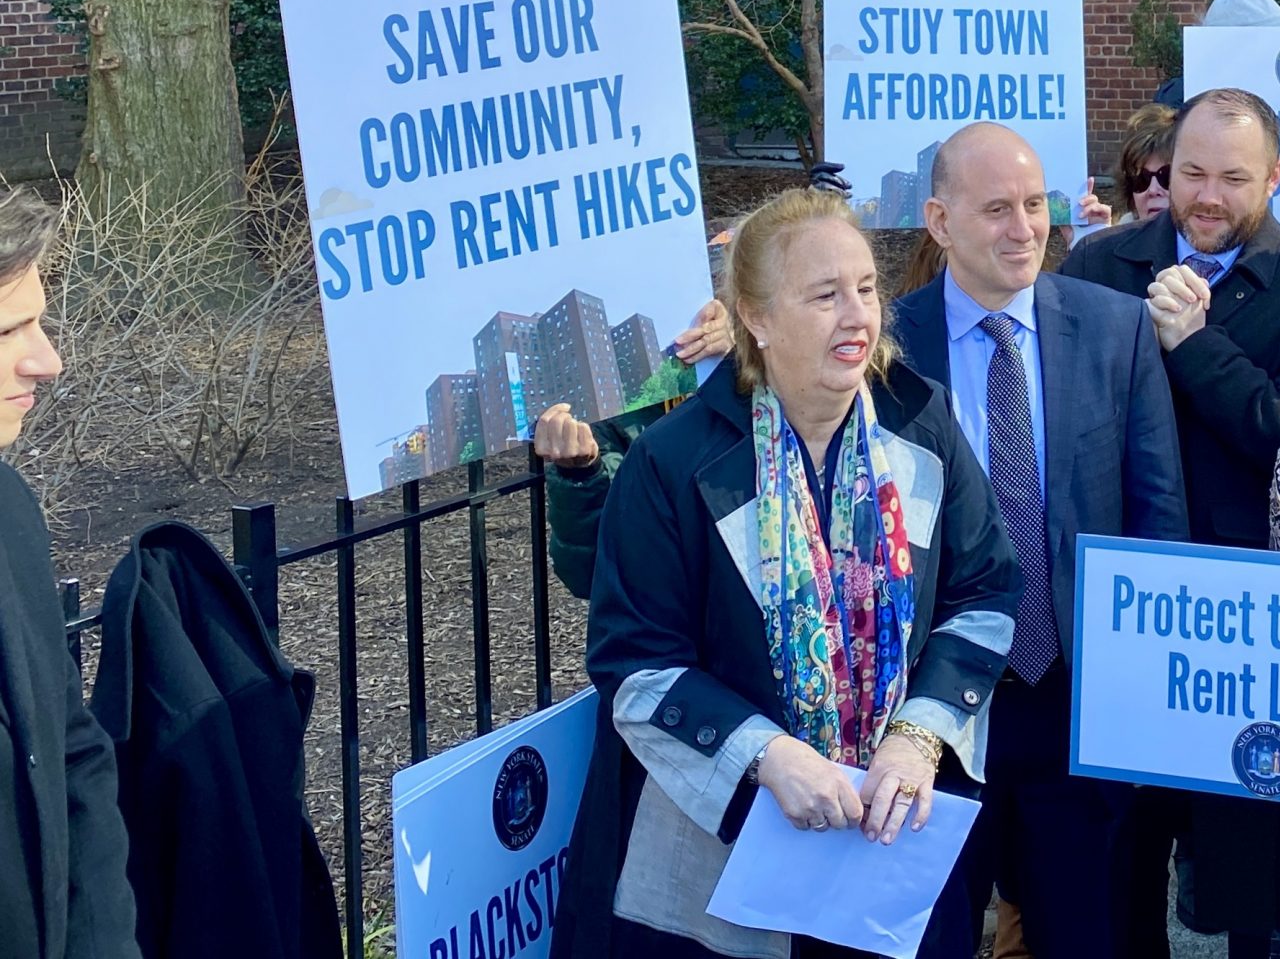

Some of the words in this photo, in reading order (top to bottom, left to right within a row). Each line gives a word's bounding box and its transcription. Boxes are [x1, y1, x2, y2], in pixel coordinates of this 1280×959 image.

[383, 1, 501, 85] SAVE
[858, 6, 944, 55] STUY
[953, 9, 1049, 56] TOWN
[360, 74, 642, 189] COMMUNITY,
[842, 73, 1066, 121] AFFORDABLE!
[319, 209, 436, 300] STOP
[450, 180, 560, 270] RENT
[574, 153, 697, 240] HIKES
[1112, 574, 1255, 647] Protect
[1167, 651, 1256, 720] Rent
[1237, 729, 1252, 749] NEW
[1252, 725, 1277, 736] YORK
[1249, 782, 1280, 794] SENATE
